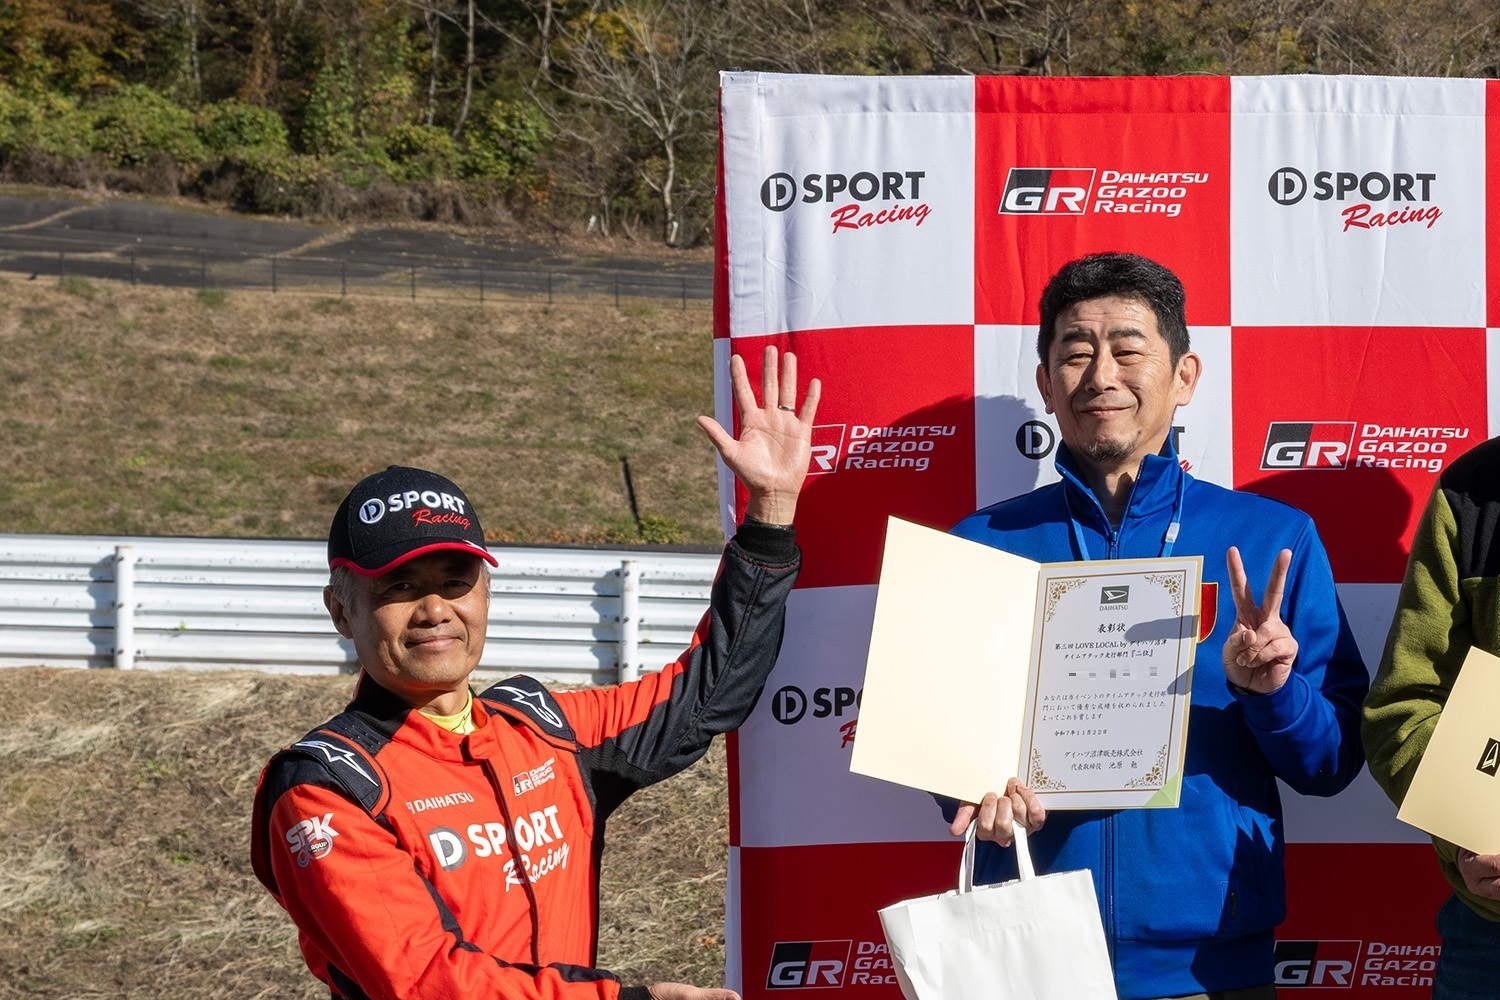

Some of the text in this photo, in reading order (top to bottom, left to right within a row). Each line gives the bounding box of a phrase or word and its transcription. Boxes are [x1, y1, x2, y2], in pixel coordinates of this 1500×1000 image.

[1100, 170, 1209, 185] DAIHATSU
[802, 171, 925, 204] SPORT
[1097, 185, 1186, 200] GAZOO
[1313, 171, 1436, 202] SPORT
[1003, 187, 1089, 213] GR
[1093, 200, 1182, 217] Racing
[831, 203, 932, 234] Racing
[1341, 203, 1443, 232] Racing
[850, 425, 956, 440] DAIHATSU
[1361, 425, 1468, 439] DAIHATSU
[847, 440, 934, 455] GAZOO
[1267, 441, 1349, 467] GR
[1358, 440, 1447, 454] GAZOO
[845, 455, 930, 472] Racing
[1355, 455, 1443, 473] Racing
[387, 490, 465, 515] SPORT
[411, 508, 471, 531] Racing
[1099, 604, 1128, 612] DAIHATSU
[1097, 622, 1126, 633] 表彰状
[1095, 641, 1118, 649] LOCAL
[1119, 641, 1127, 649] by
[414, 792, 474, 812] DAIHATSU
[286, 813, 339, 854] SPK
[467, 805, 564, 858] SPORT
[503, 841, 569, 892] Racing
[1366, 943, 1440, 956] DAIHAT
[771, 960, 843, 985] GR
[1363, 957, 1435, 971] GAZO
[851, 972, 896, 985] Rac
[1274, 961, 1351, 986] GR
[1360, 971, 1432, 987] Racin
